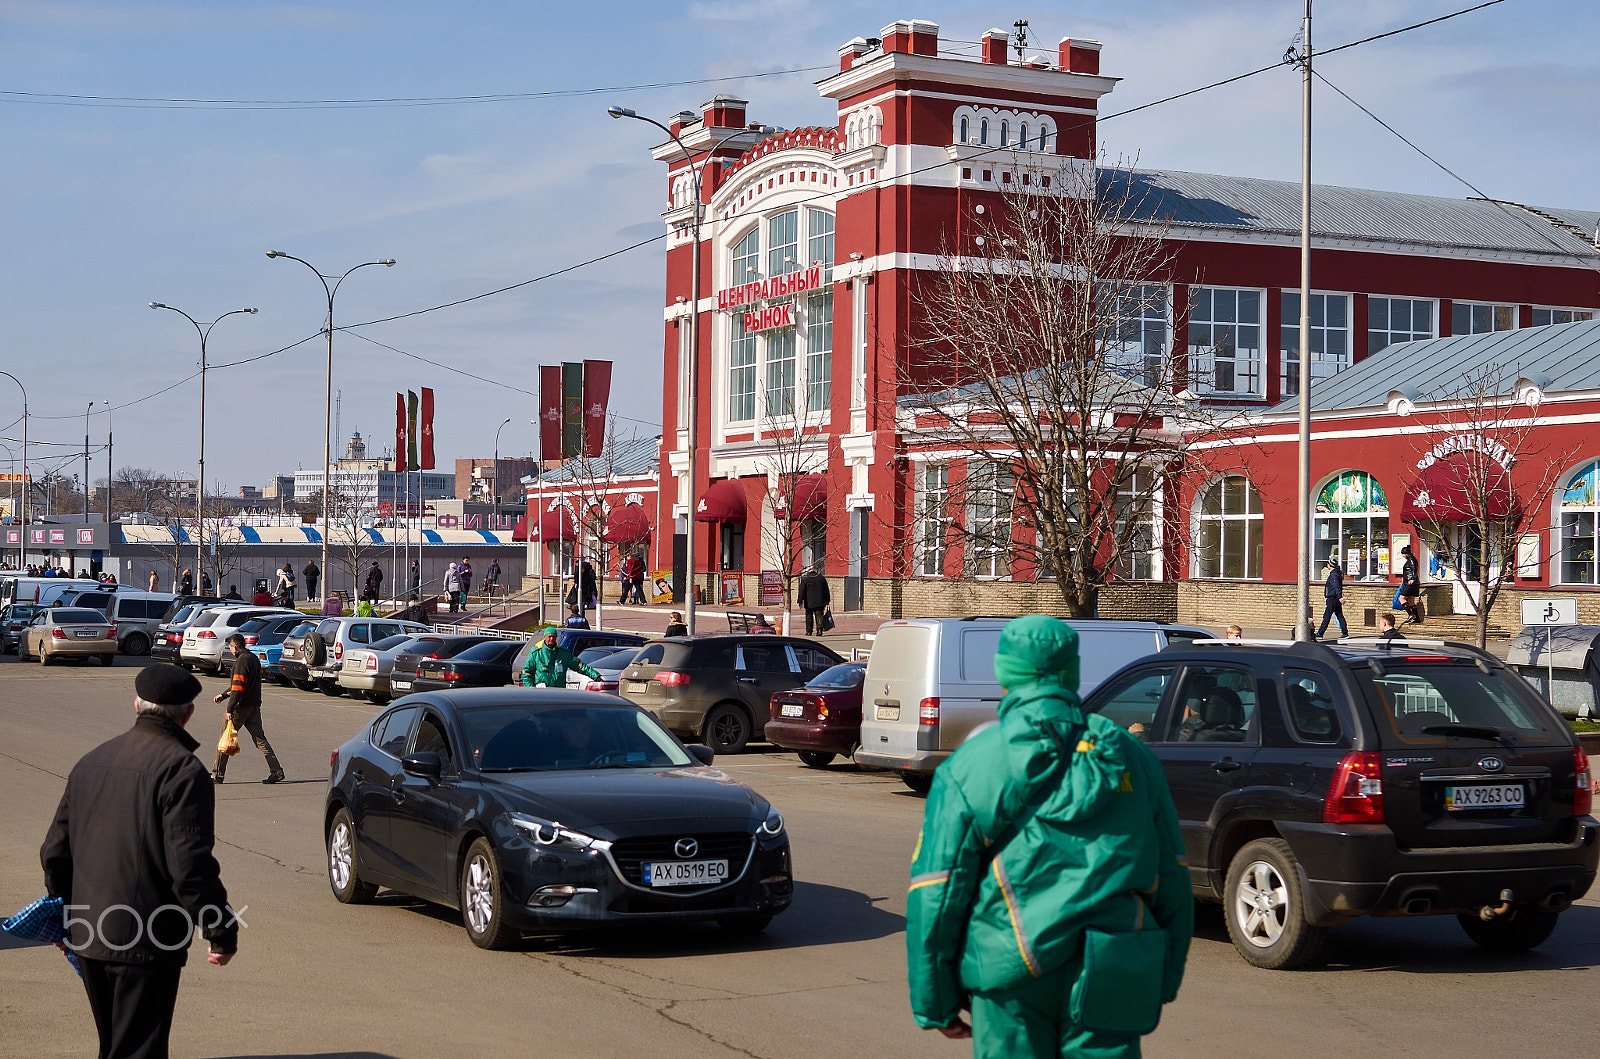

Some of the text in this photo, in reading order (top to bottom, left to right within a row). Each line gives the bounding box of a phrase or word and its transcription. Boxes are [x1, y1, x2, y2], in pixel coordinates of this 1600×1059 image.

[718, 260, 820, 311] ЦЕНТРАЛЬНЫЙ
[743, 304, 791, 333] РЫНОК
[437, 513, 523, 529] ФИШ
[1454, 787, 1522, 804] AX 9263 CO
[654, 862, 725, 880] AX 0519 EO
